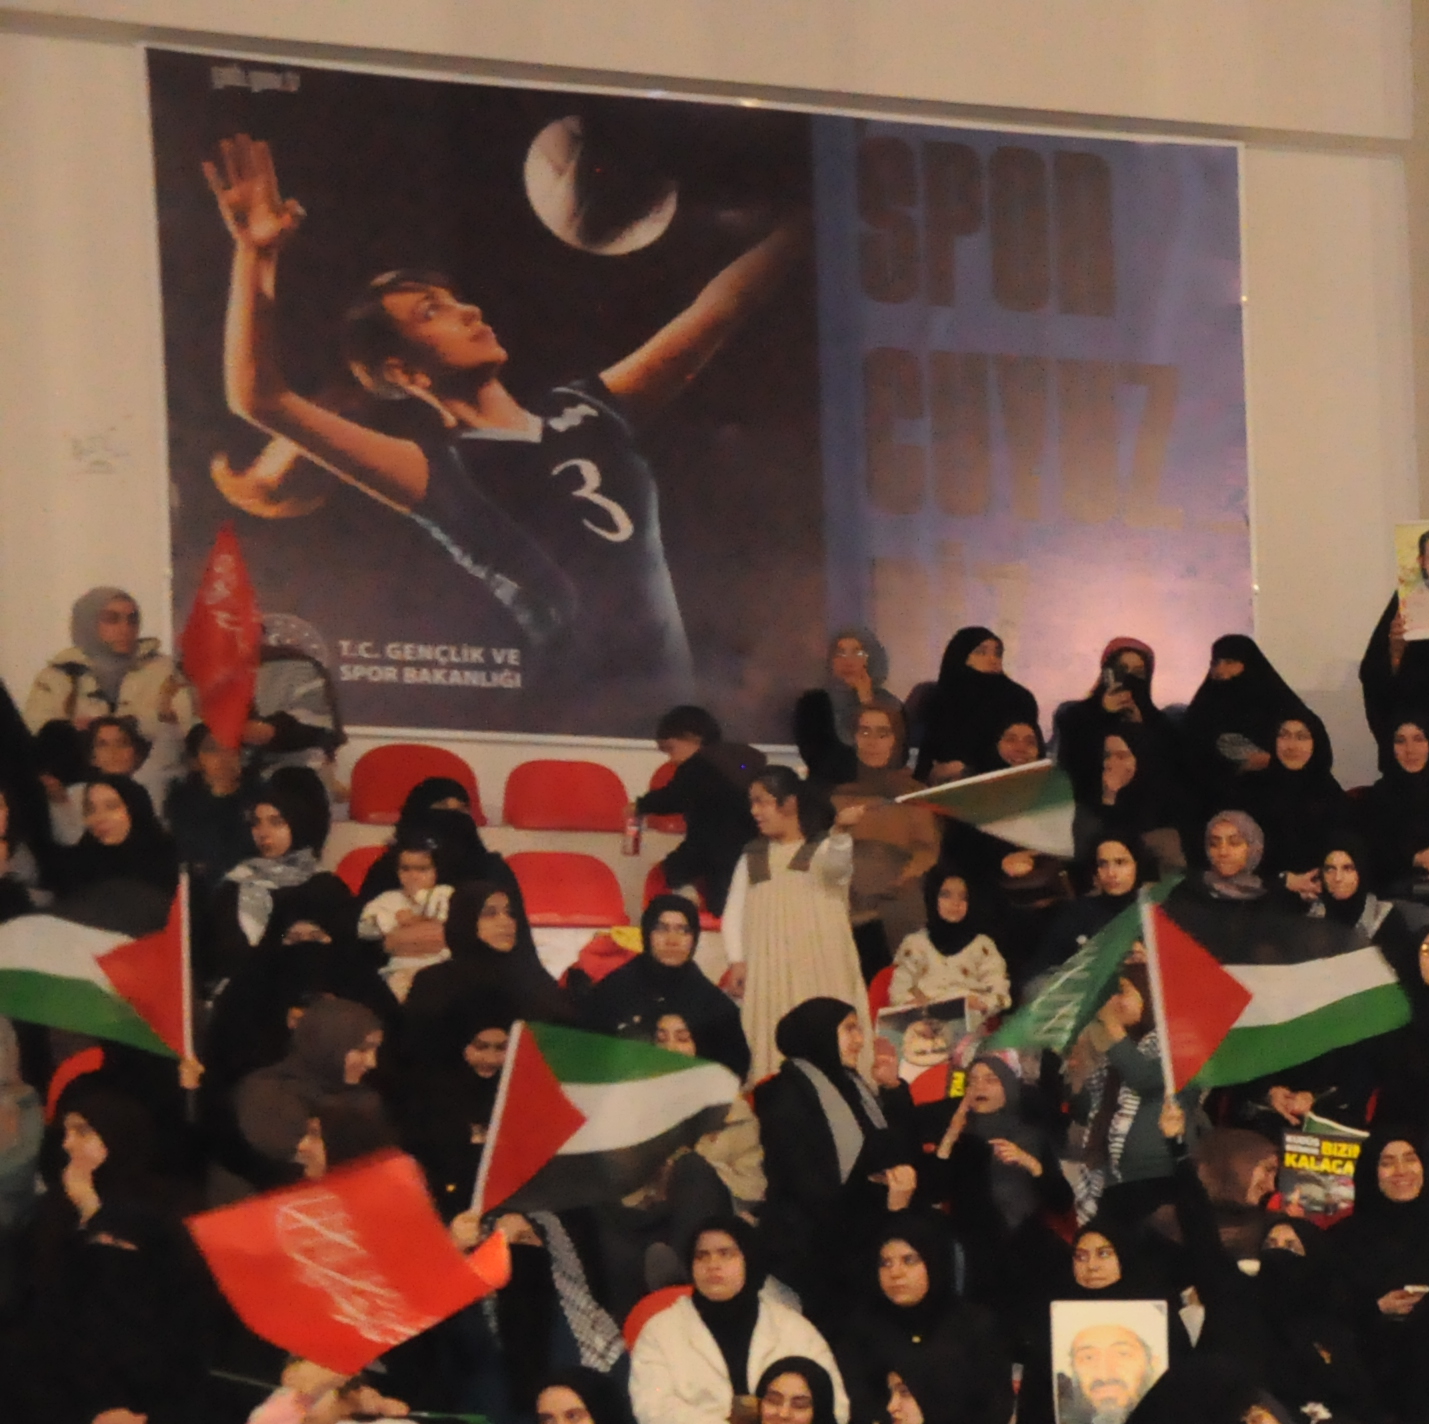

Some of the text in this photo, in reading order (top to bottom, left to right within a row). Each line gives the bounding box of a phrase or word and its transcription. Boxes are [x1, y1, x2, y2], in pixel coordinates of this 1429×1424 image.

[856, 134, 1114, 317] SPOR
[551, 458, 635, 543] 3
[339, 662, 522, 689] SPOR BAKANLIĞI
[384, 640, 486, 666] GENÇLİK
[491, 646, 521, 666] VE
